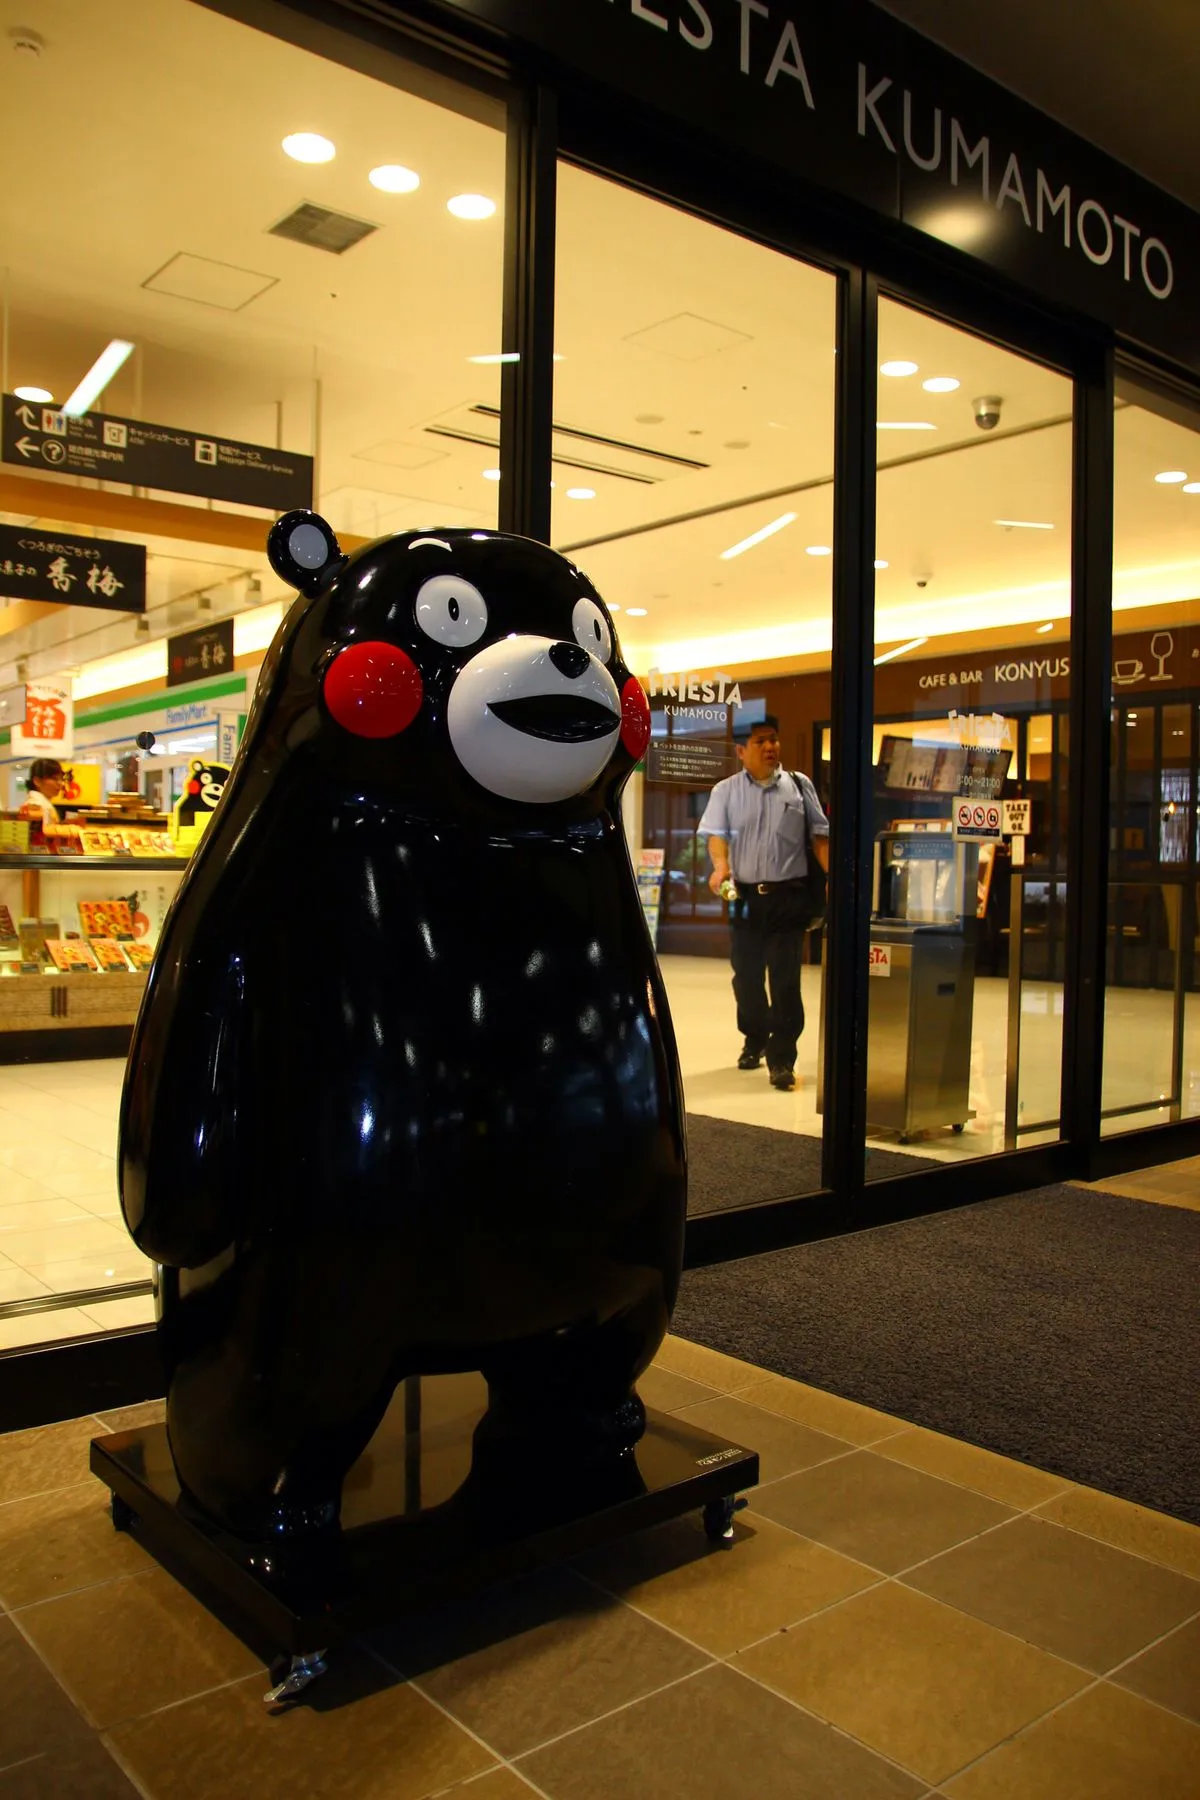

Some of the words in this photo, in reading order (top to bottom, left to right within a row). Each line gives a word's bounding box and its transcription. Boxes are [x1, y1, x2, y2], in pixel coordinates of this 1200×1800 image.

[857, 61, 1174, 300] KUMAMOTO
[919, 673, 947, 688] CAFE
[949, 672, 958, 685] &
[960, 670, 984, 684] BAR
[994, 656, 1071, 683] KONYUS
[648, 667, 743, 709] FRIESTA
[663, 704, 728, 722] KUMAMOTO
[1006, 803, 1029, 813] TAKE
[1009, 813, 1025, 822] OUT
[1011, 823, 1023, 832] OK
